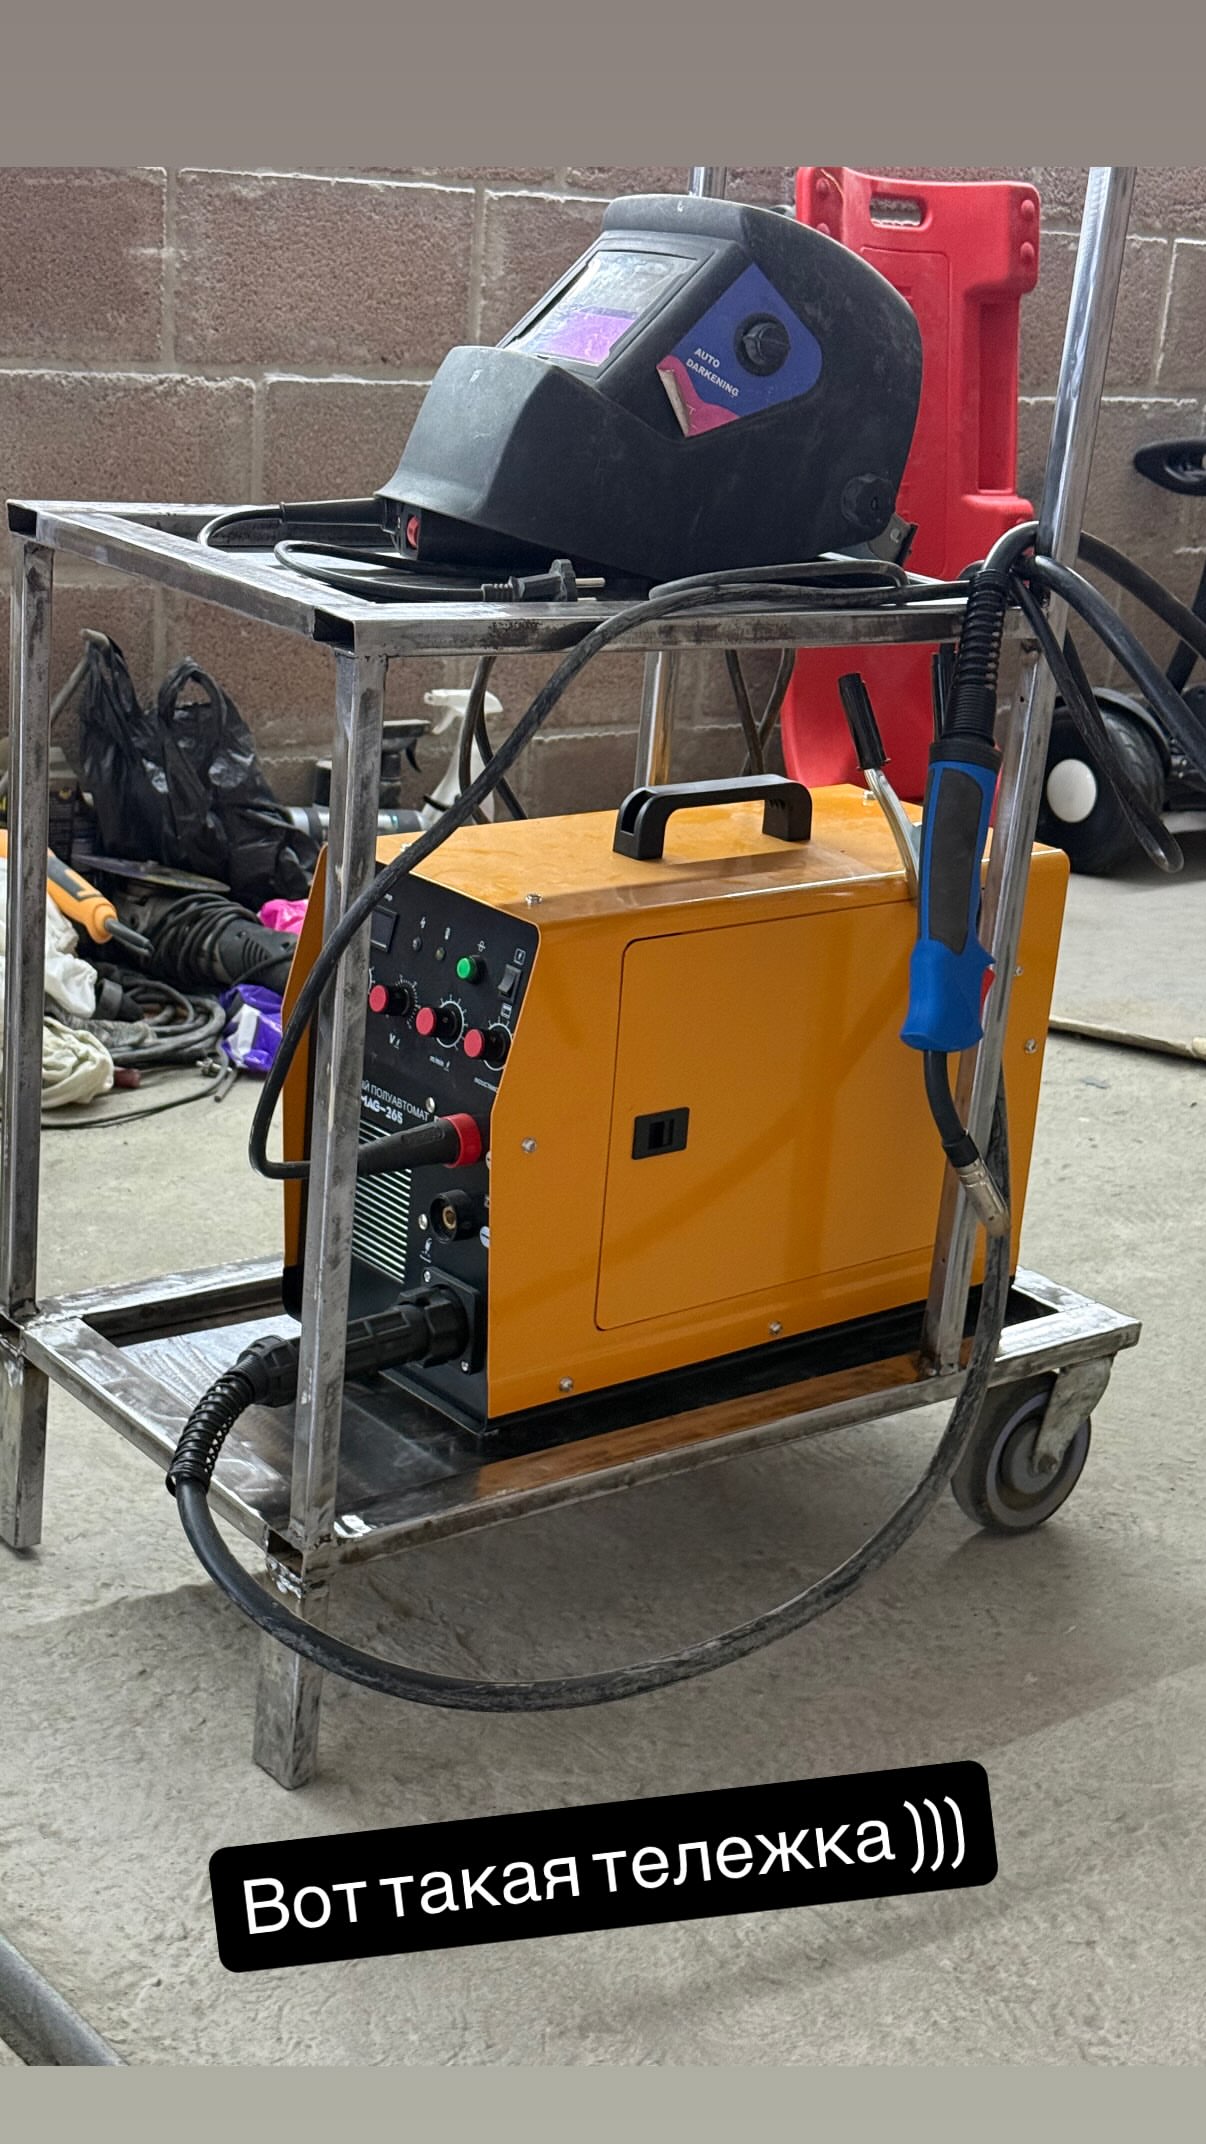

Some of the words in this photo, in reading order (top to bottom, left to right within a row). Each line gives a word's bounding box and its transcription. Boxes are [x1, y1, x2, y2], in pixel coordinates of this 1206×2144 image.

[694, 347, 721, 369] AUTO
[686, 358, 740, 397] DARKENING
[370, 1084, 430, 1122] ПОЛУАВТОМАТ
